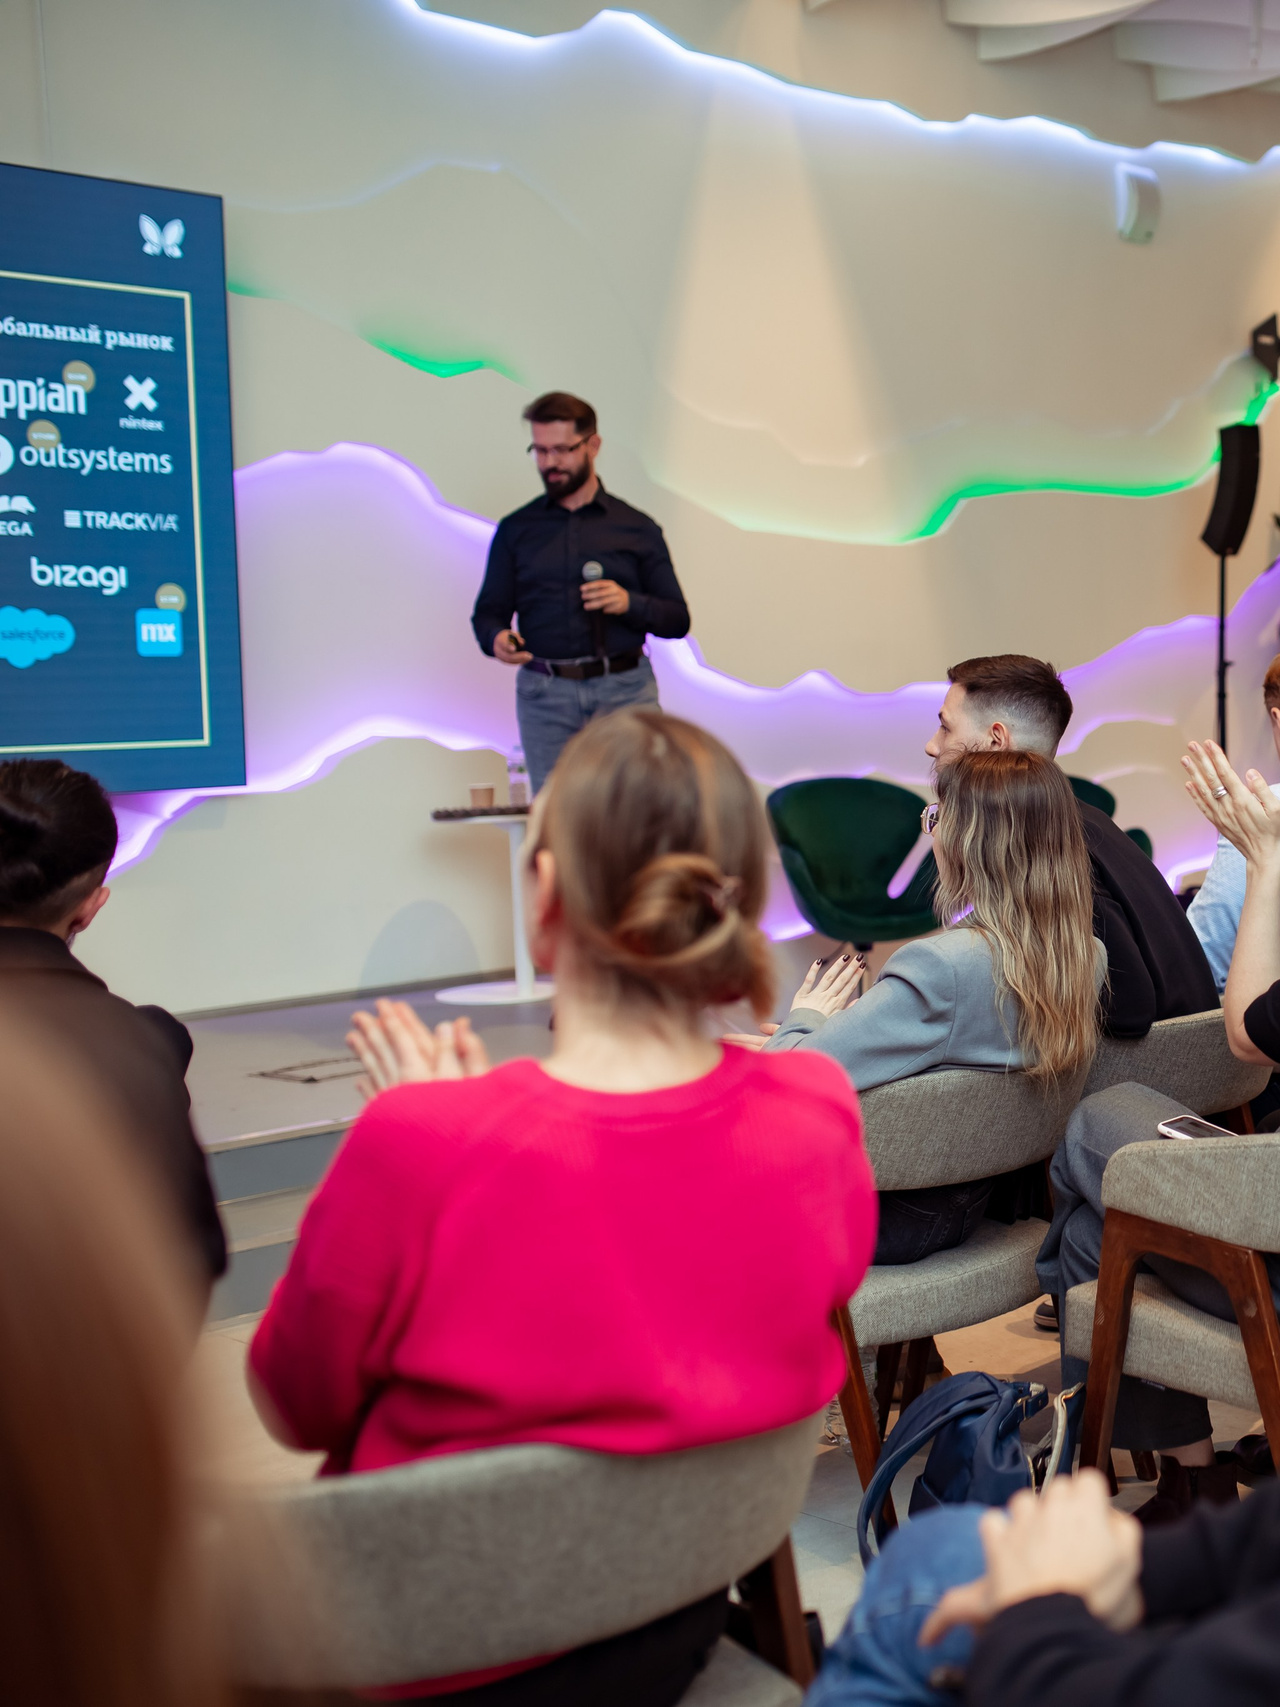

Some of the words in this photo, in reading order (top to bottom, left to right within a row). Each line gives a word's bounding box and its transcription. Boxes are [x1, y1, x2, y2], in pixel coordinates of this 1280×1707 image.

[104, 329, 174, 351] рынок
[119, 415, 165, 432] nintex
[19, 443, 174, 476] outsystems
[83, 510, 179, 532] TRACKVIA
[30, 556, 128, 596] bizagi
[141, 623, 176, 642] mx
